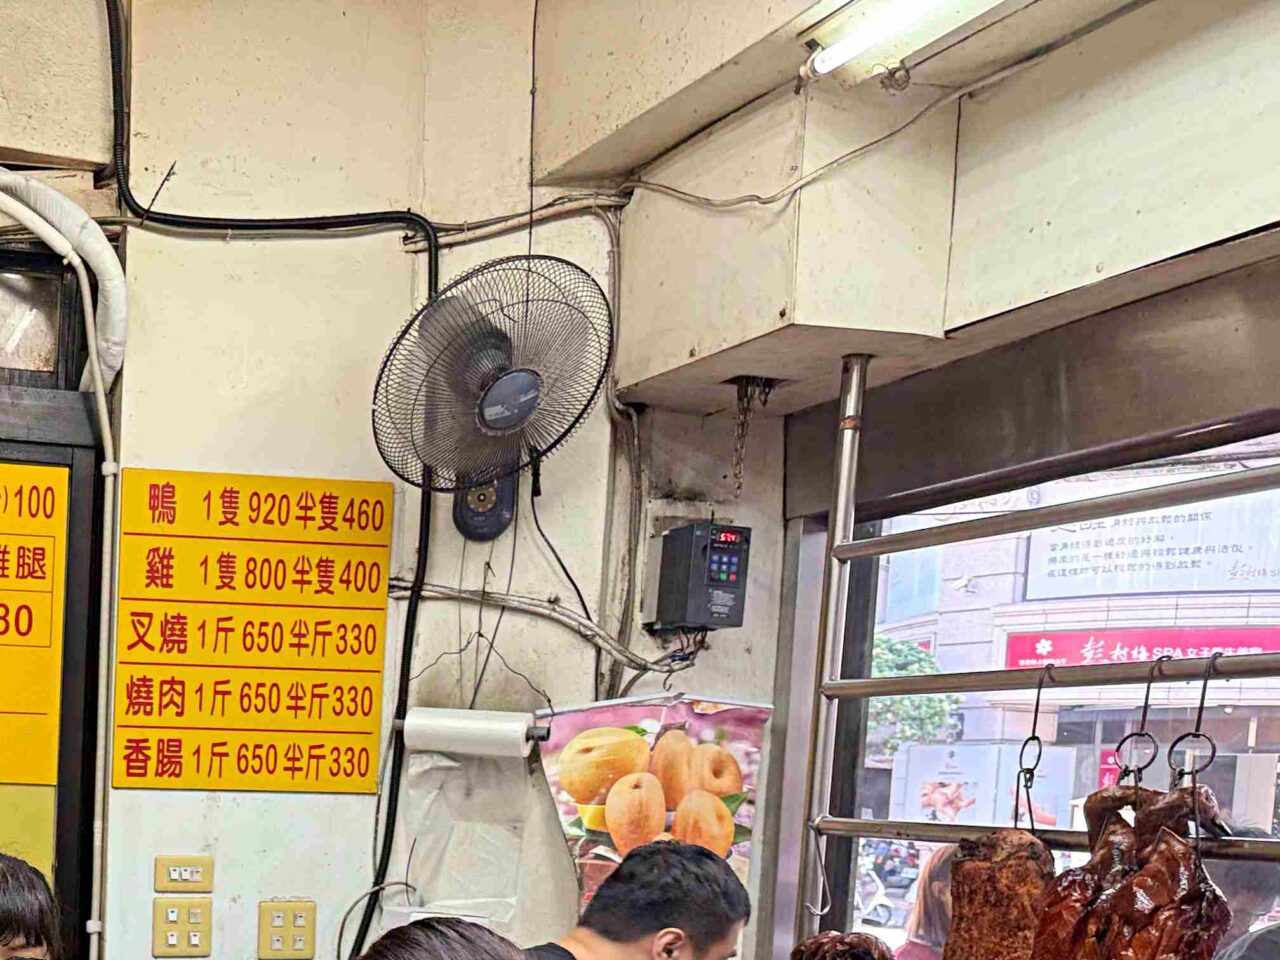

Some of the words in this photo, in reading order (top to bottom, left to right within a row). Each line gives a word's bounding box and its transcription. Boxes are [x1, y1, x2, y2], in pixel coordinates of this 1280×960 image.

[147, 482, 177, 525] 鴨
[145, 545, 175, 589] 雞
[126, 610, 188, 655] 叉燒
[125, 674, 186, 717] 燒肉
[122, 737, 184, 778] 香腸
